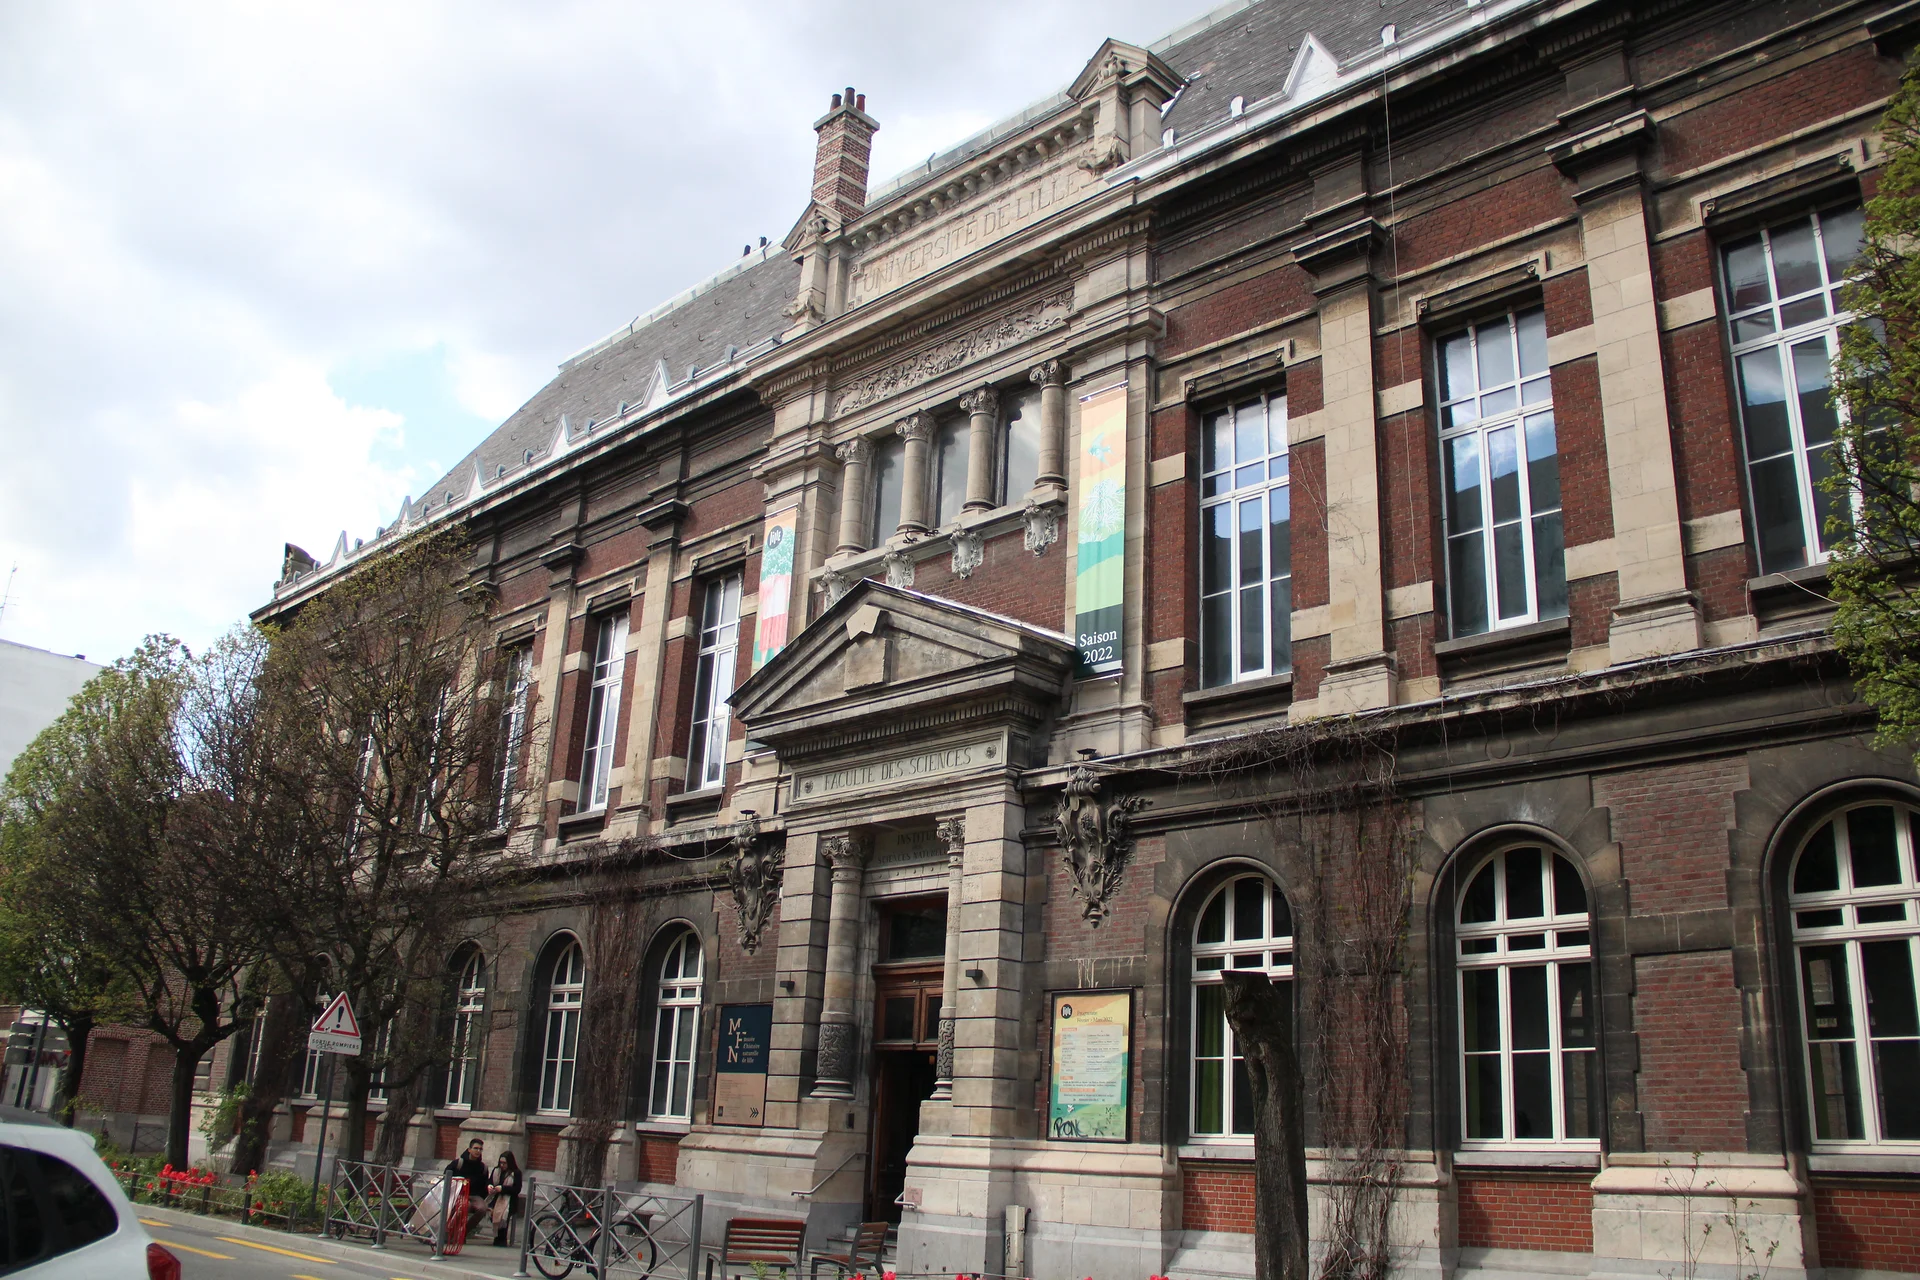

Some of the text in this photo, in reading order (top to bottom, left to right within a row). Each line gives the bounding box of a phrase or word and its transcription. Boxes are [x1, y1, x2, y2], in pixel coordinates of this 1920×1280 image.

[863, 169, 1080, 293] UNIVERSITÉ DE LILLE
[1080, 630, 1117, 647] Saison
[1083, 645, 1113, 664] 2022
[881, 760, 904, 781] DES
[908, 747, 972, 775] SCIENCES
